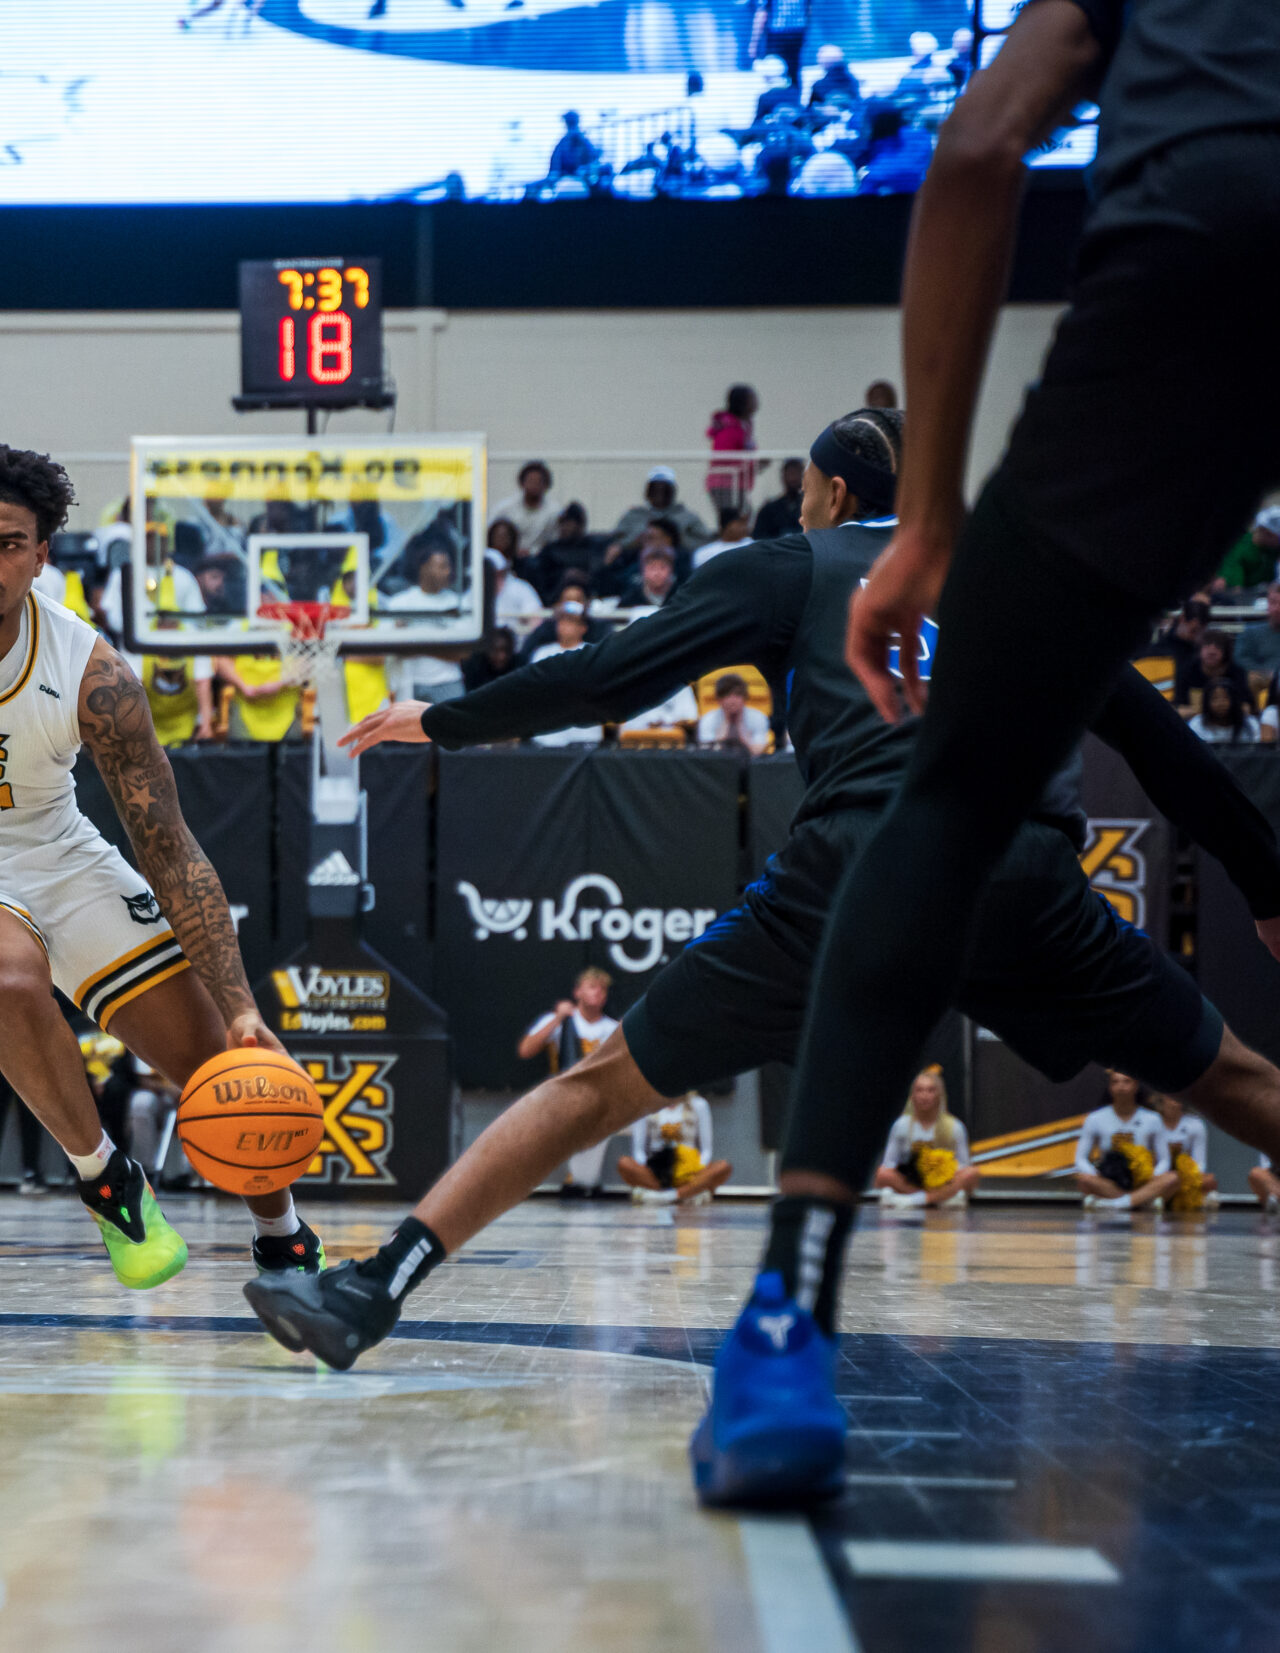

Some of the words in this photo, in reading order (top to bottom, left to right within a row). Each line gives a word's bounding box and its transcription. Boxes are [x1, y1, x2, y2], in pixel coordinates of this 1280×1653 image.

[277, 266, 370, 312] 7:37
[278, 310, 353, 384] 18
[539, 873, 718, 973] Kroger
[212, 1075, 308, 1105] Wilson
